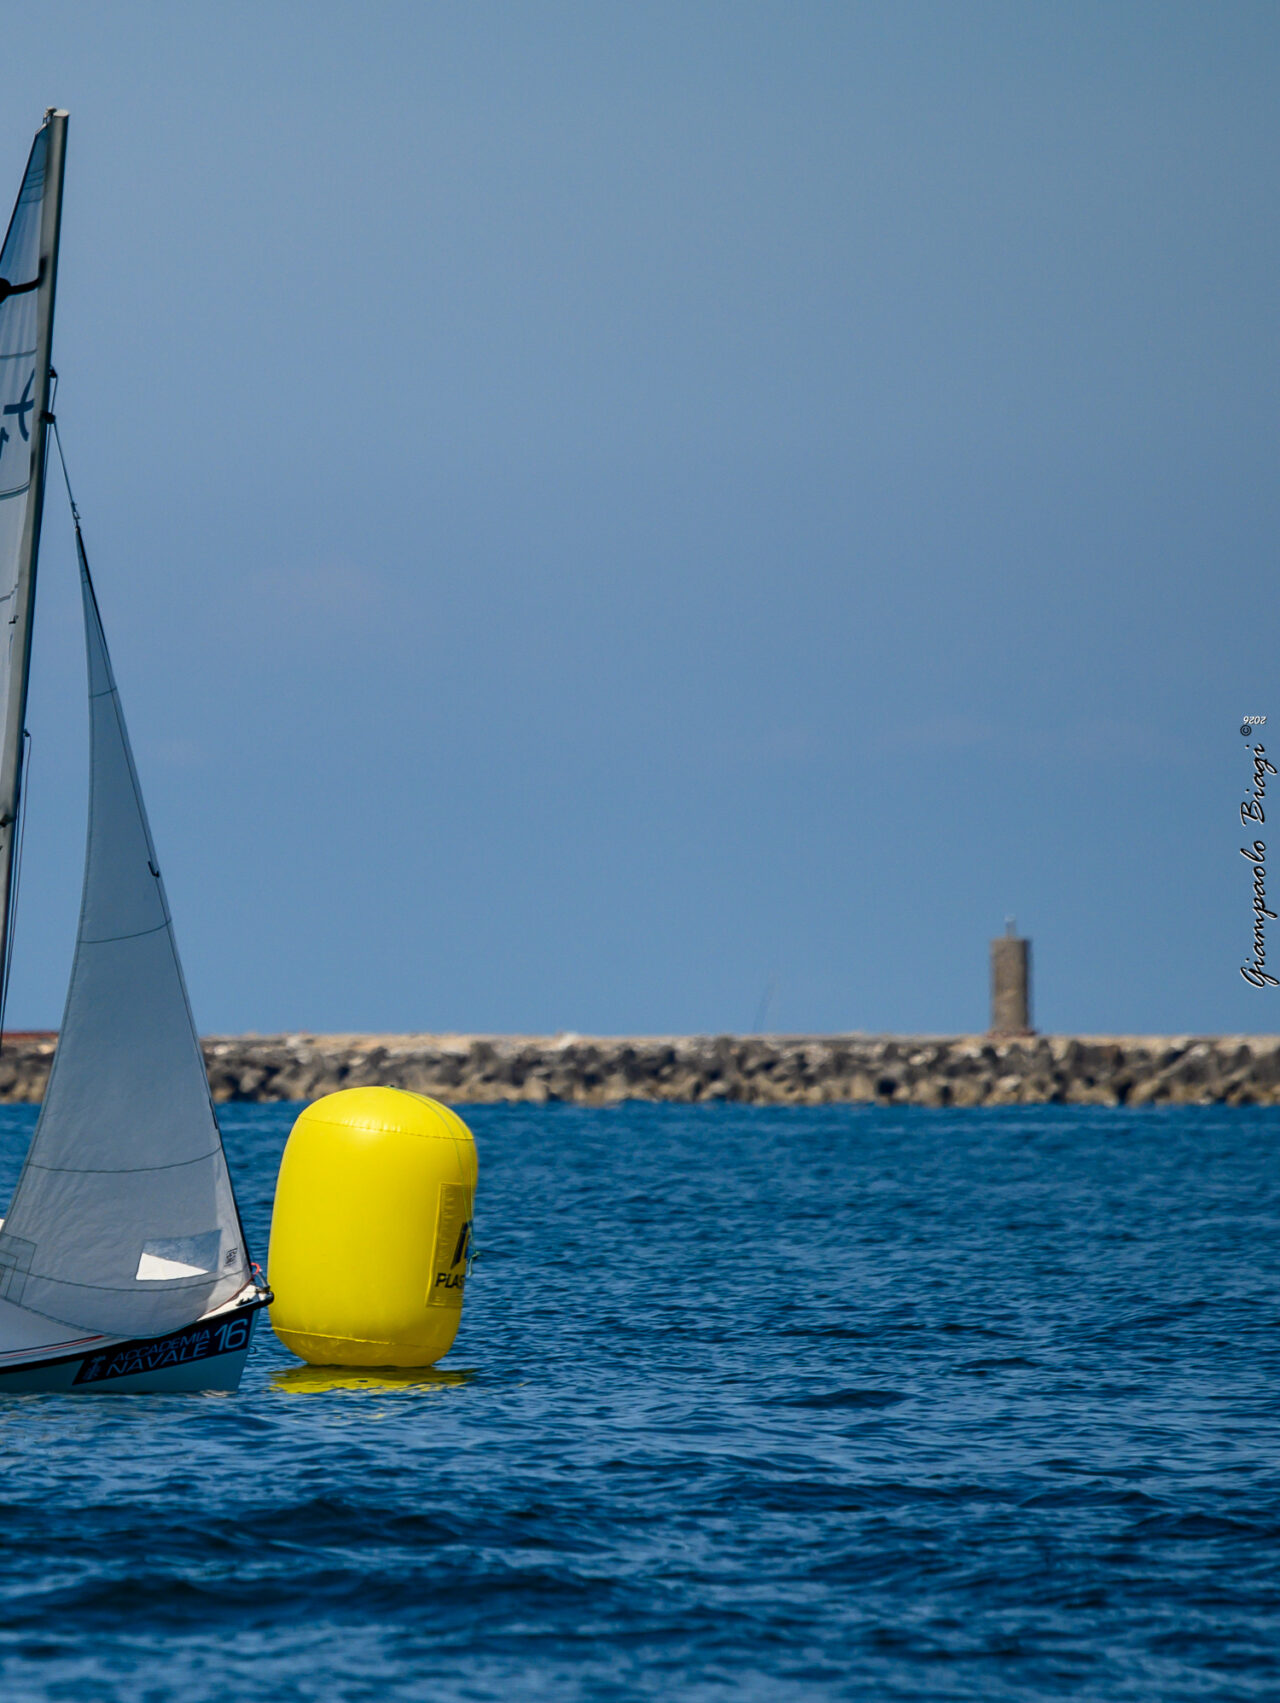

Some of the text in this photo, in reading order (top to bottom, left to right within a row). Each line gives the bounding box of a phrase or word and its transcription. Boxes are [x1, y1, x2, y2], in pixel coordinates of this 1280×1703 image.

[112, 1329, 211, 1362] ACCADEMIA
[214, 1318, 249, 1352] 16
[106, 1340, 210, 1376] NAVALE
